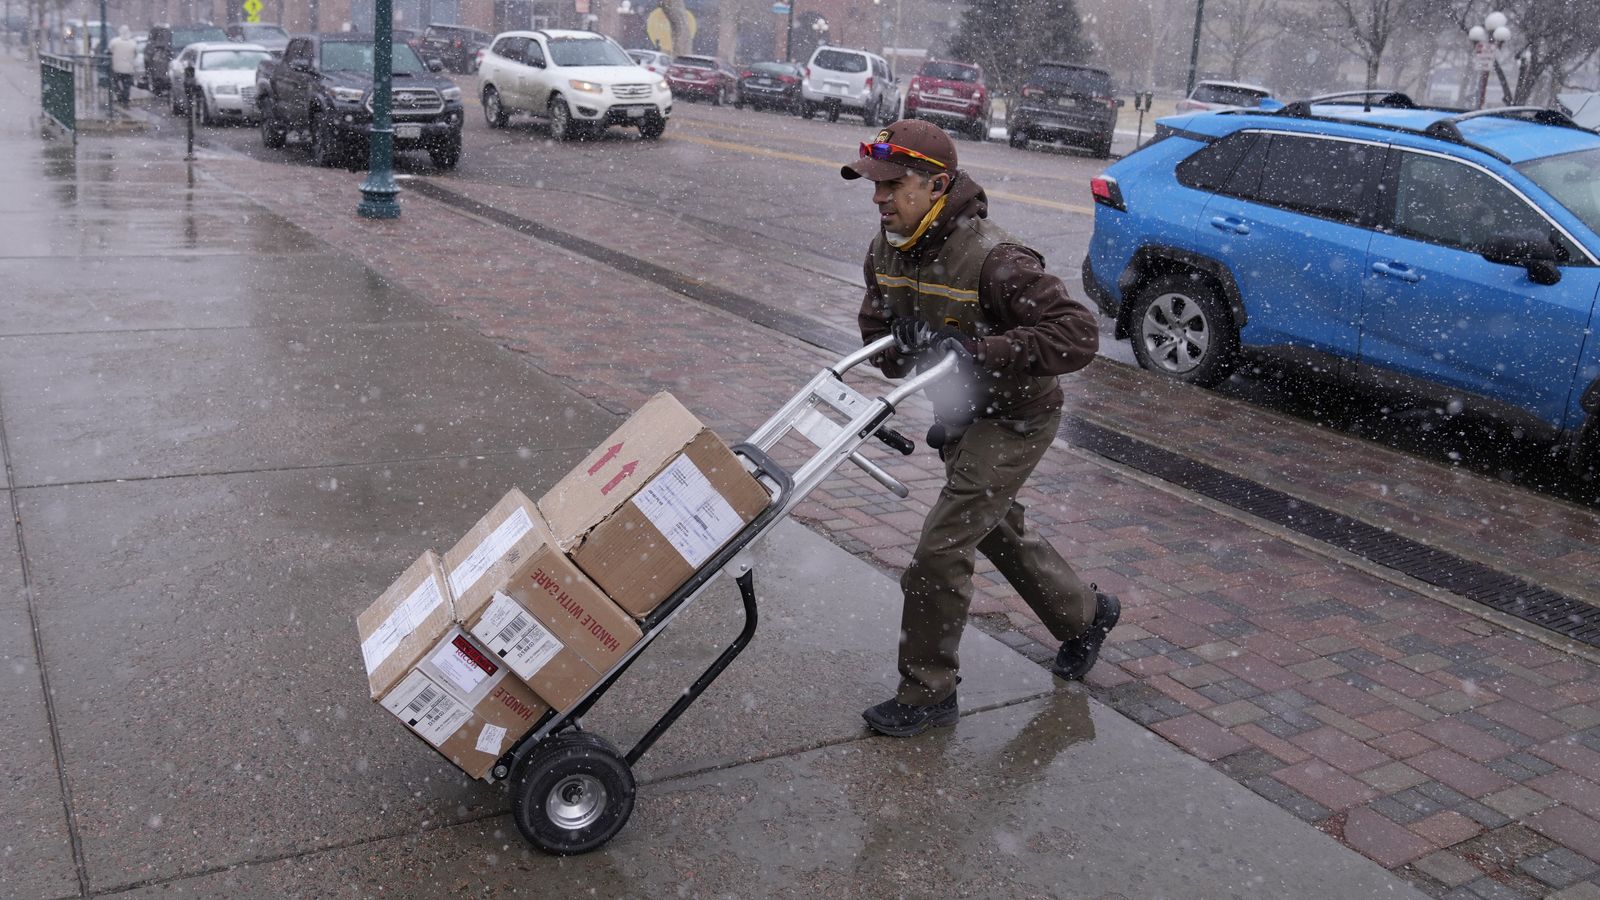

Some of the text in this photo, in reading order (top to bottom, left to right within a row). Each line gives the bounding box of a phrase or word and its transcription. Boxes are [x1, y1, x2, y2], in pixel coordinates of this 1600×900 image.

[530, 567, 560, 596] CARE
[556, 591, 584, 620] WITH
[580, 614, 620, 652] HANDLE
[455, 648, 478, 669] RICOH
[494, 686, 533, 721] HANDLE
